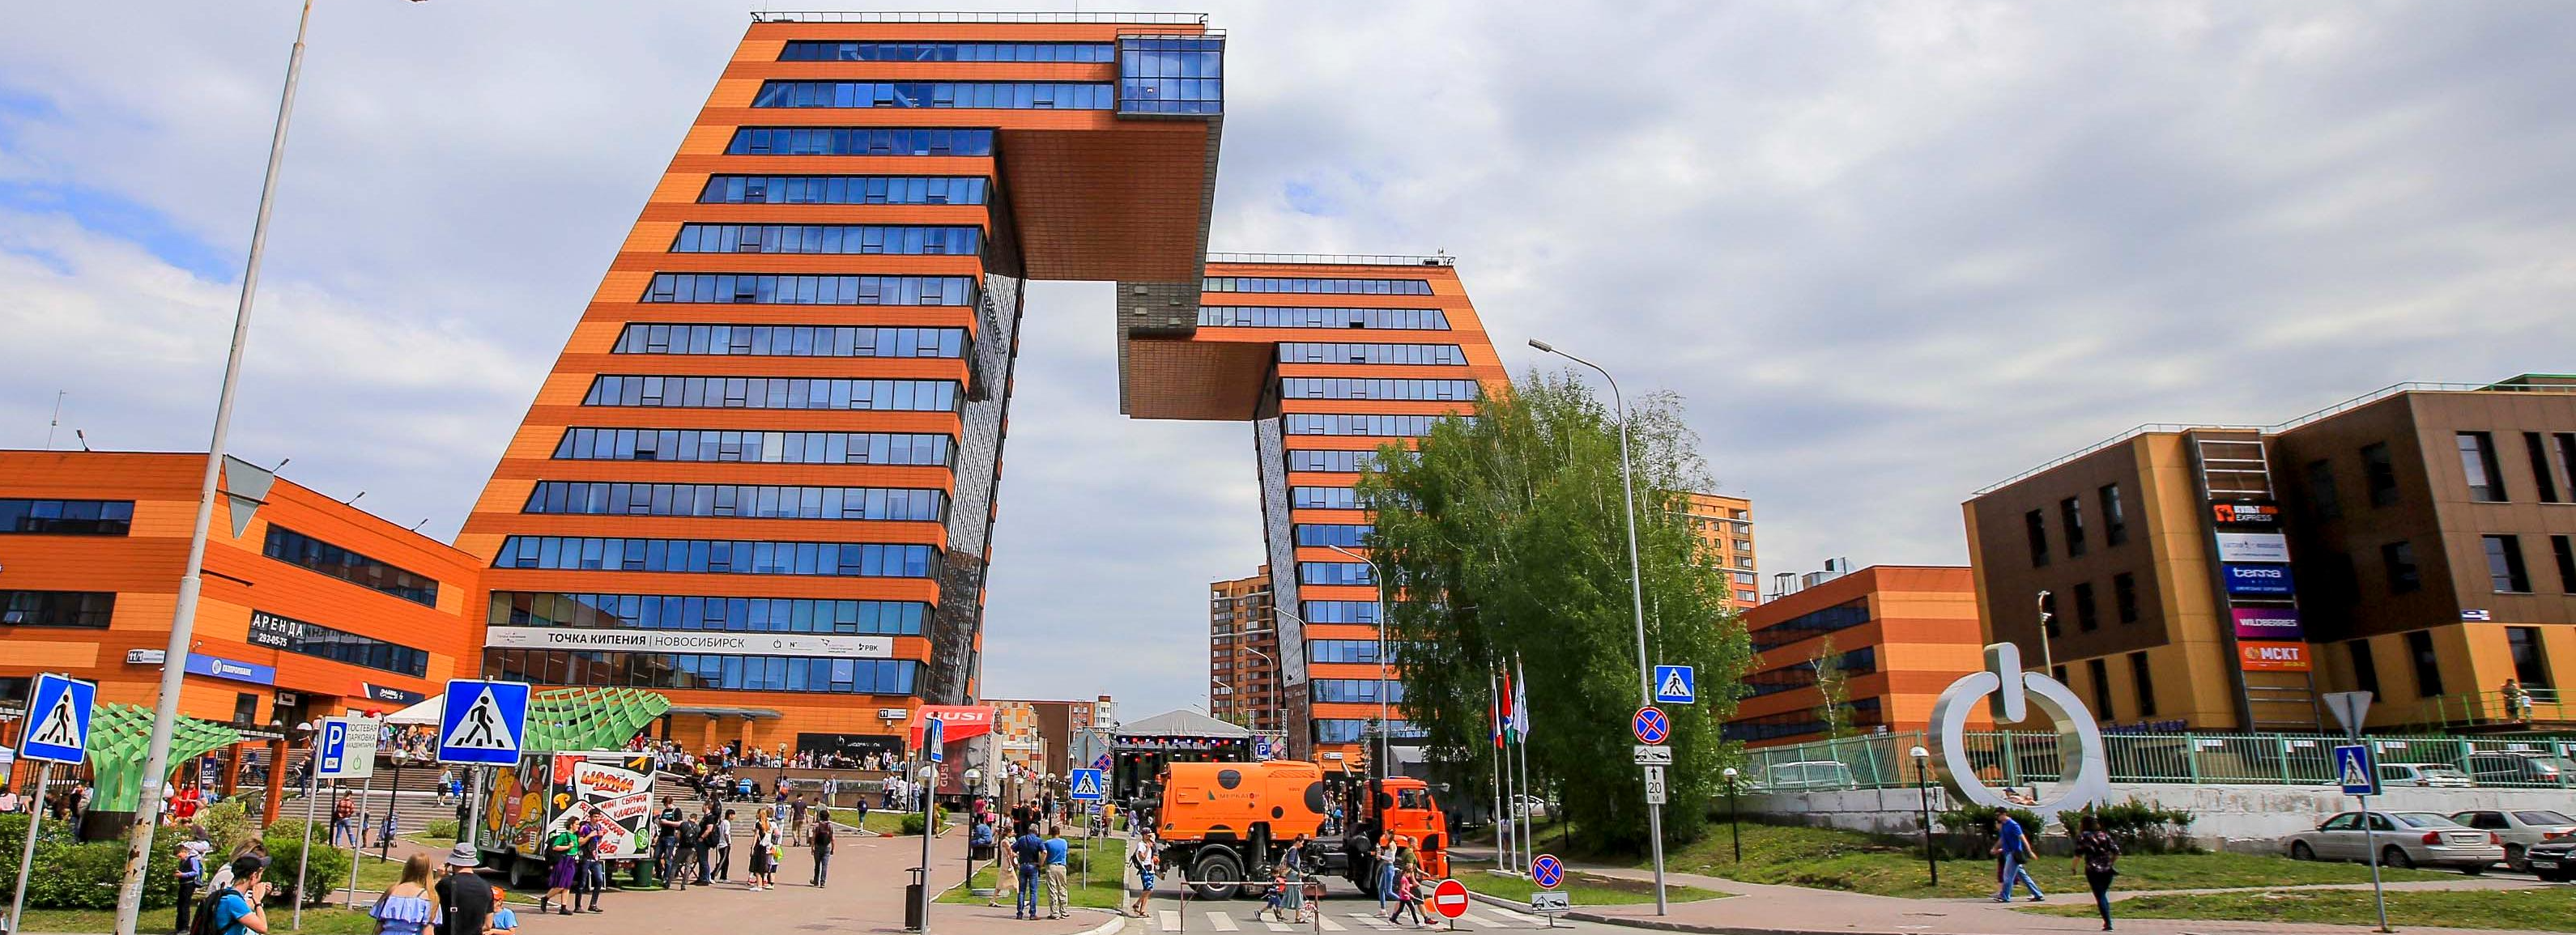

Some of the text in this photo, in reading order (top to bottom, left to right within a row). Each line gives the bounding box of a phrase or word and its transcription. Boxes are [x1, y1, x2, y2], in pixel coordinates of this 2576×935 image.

[2233, 567, 2282, 578] terra
[253, 614, 304, 637] АРЕНДА
[2239, 618, 2298, 627] WILDBERRIES
[258, 632, 287, 647] 292-05-75
[547, 633, 745, 648] ТОЧКА КИПЕНИЯ НОВОСИБИРСК
[129, 651, 143, 662] 11/1
[2259, 647, 2299, 660] МСКТ
[879, 709, 888, 718] 11
[347, 724, 377, 732] ГОСТЕВАЯ
[327, 725, 343, 754] P
[347, 733, 376, 742] ПАРКОВКА
[940, 763, 949, 787] GUSI
[1648, 782, 1662, 793] 20
